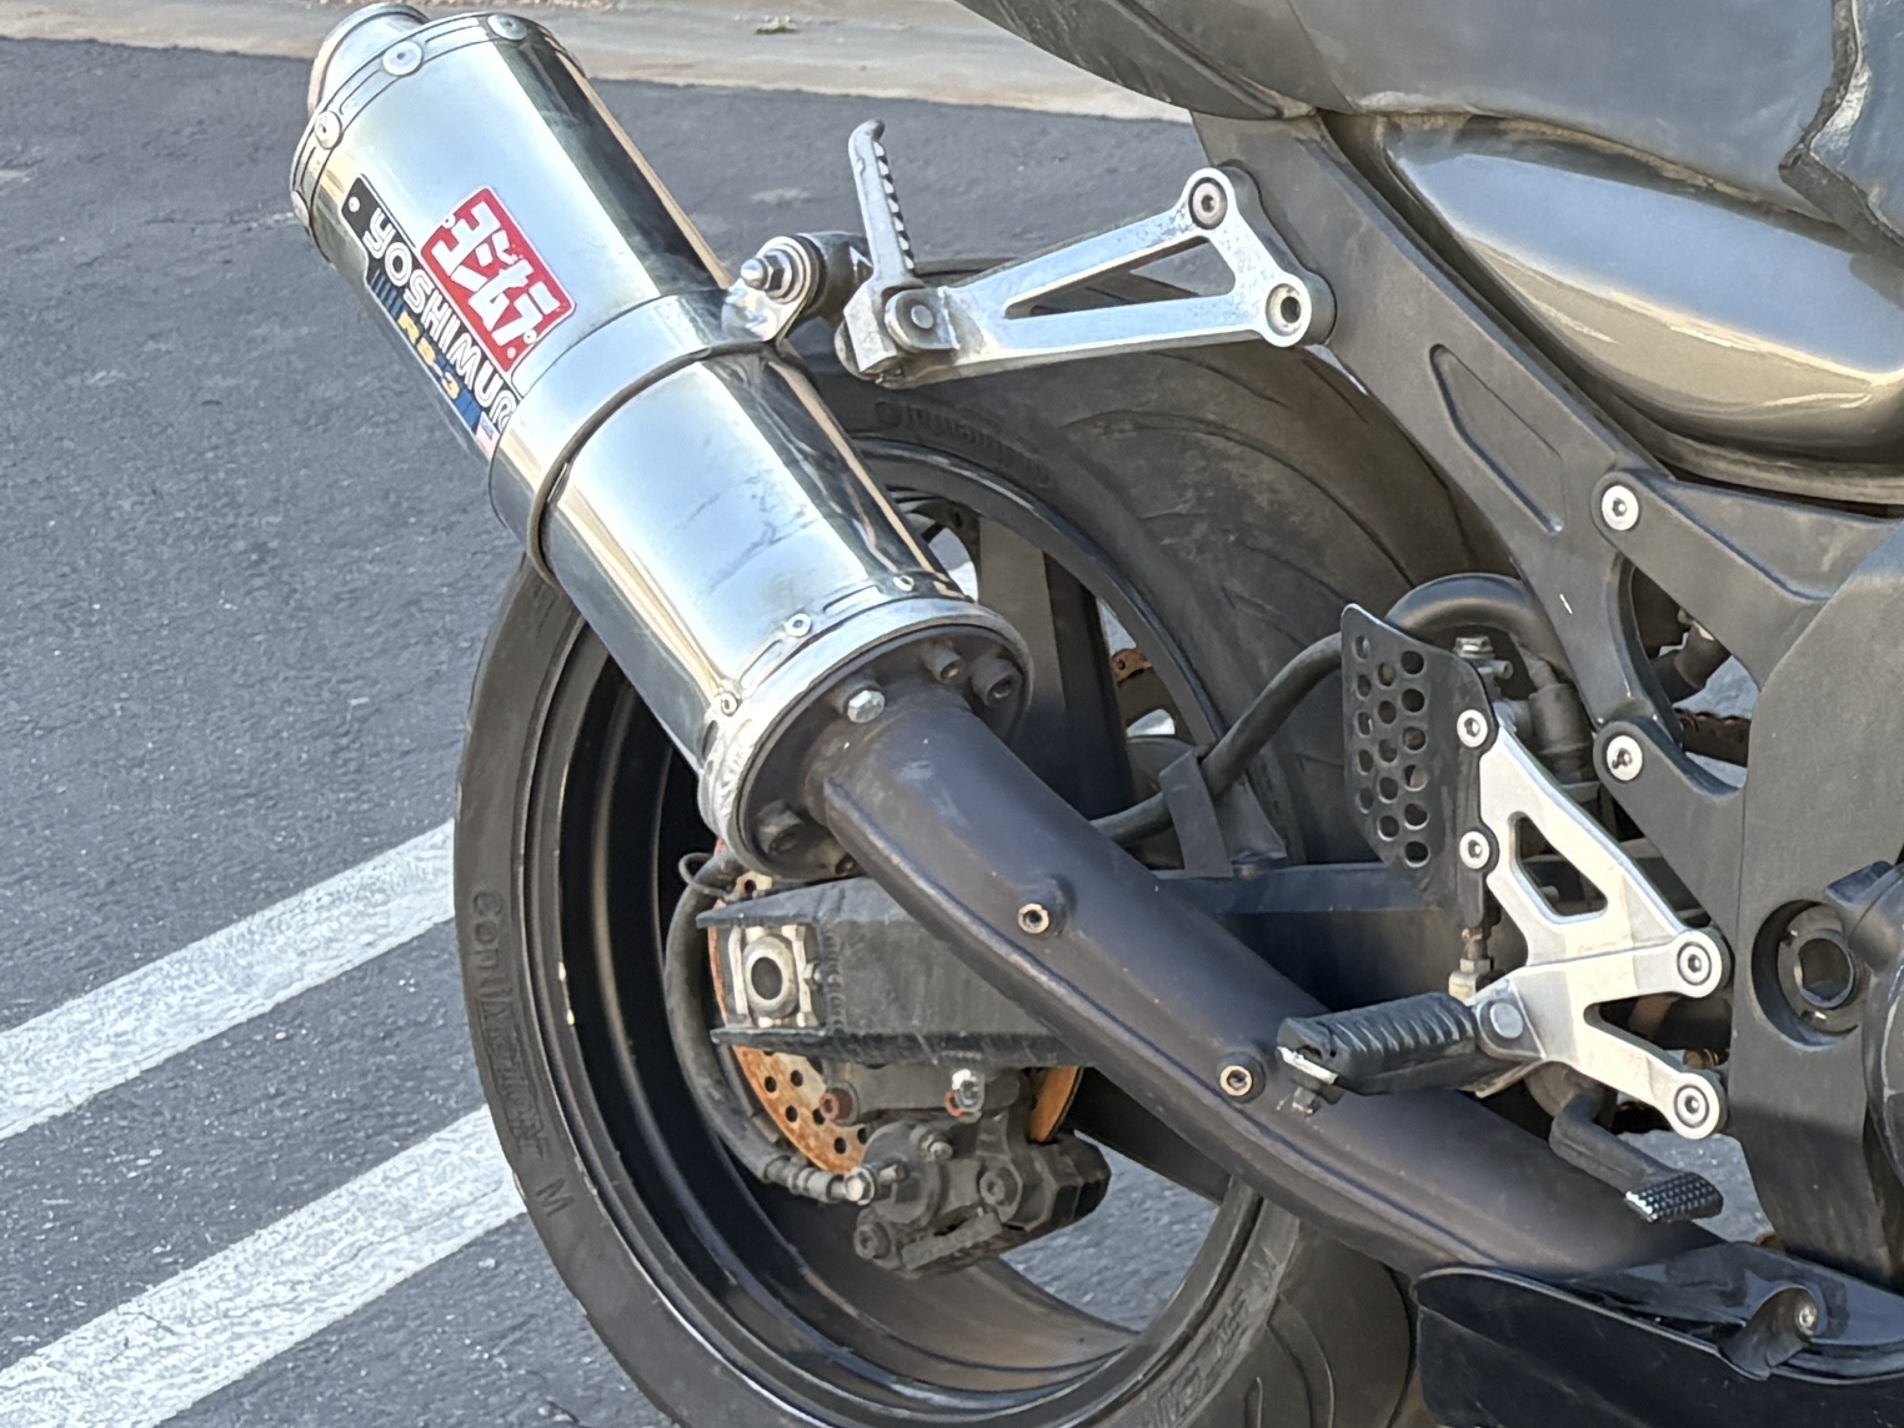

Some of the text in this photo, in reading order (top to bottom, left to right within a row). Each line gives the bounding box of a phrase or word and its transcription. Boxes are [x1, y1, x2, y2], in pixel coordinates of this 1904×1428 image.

[361, 207, 517, 430] YOSHIMUR
[431, 200, 561, 347] ヨシムラ
